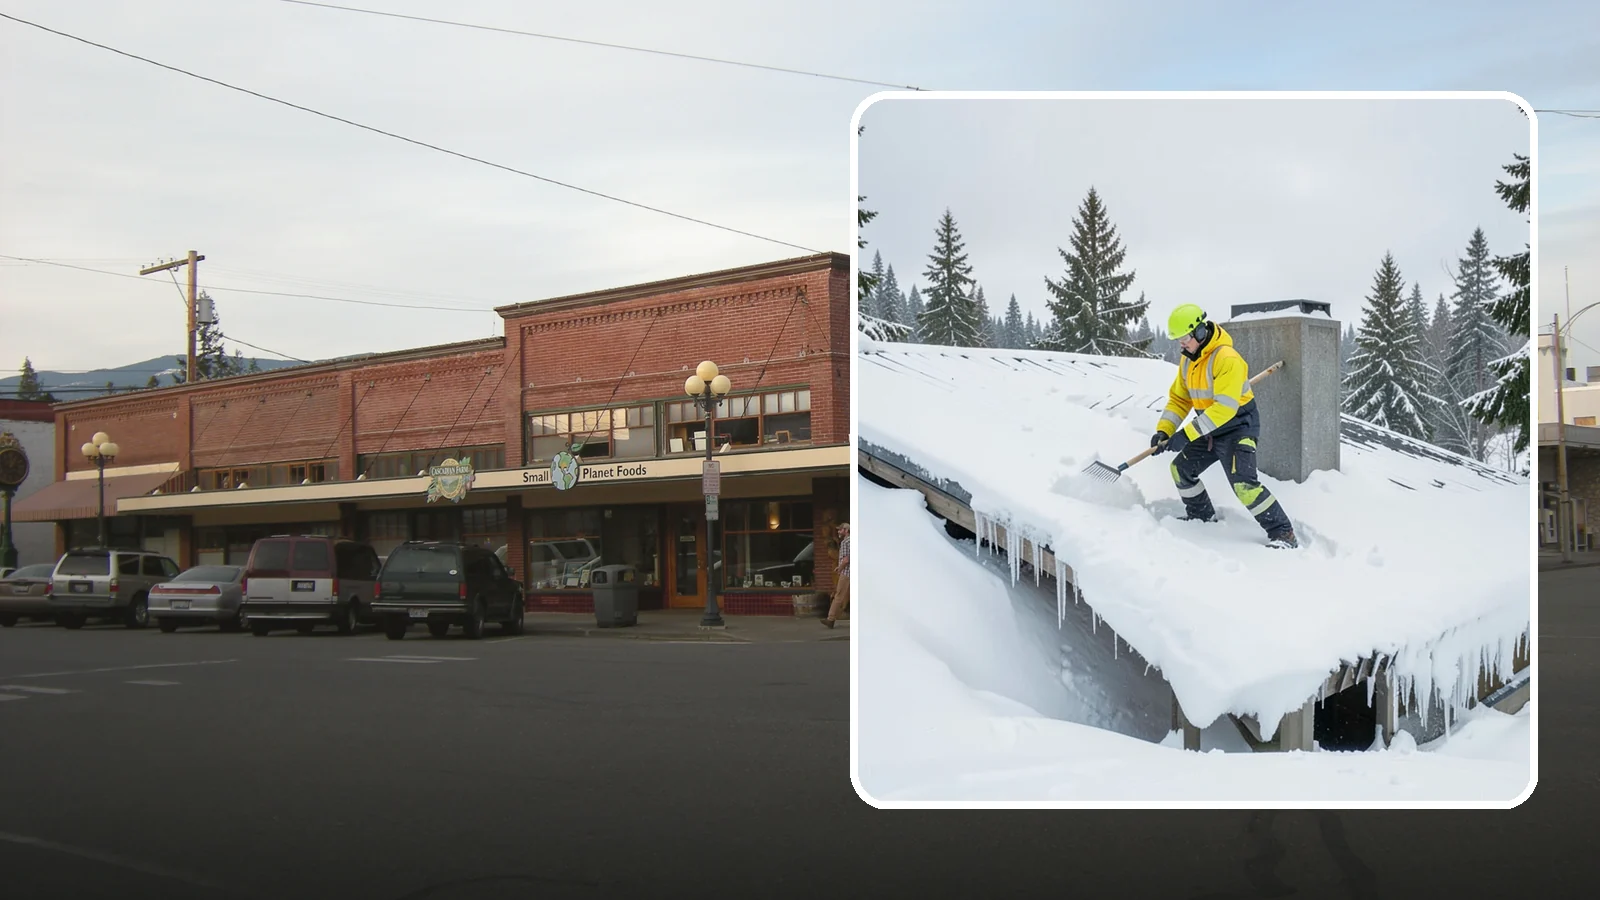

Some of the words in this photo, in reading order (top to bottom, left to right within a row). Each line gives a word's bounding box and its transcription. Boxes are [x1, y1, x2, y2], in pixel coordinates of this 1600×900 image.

[523, 471, 549, 483] Small
[583, 467, 614, 479] Planet
[616, 464, 647, 477] Foods
